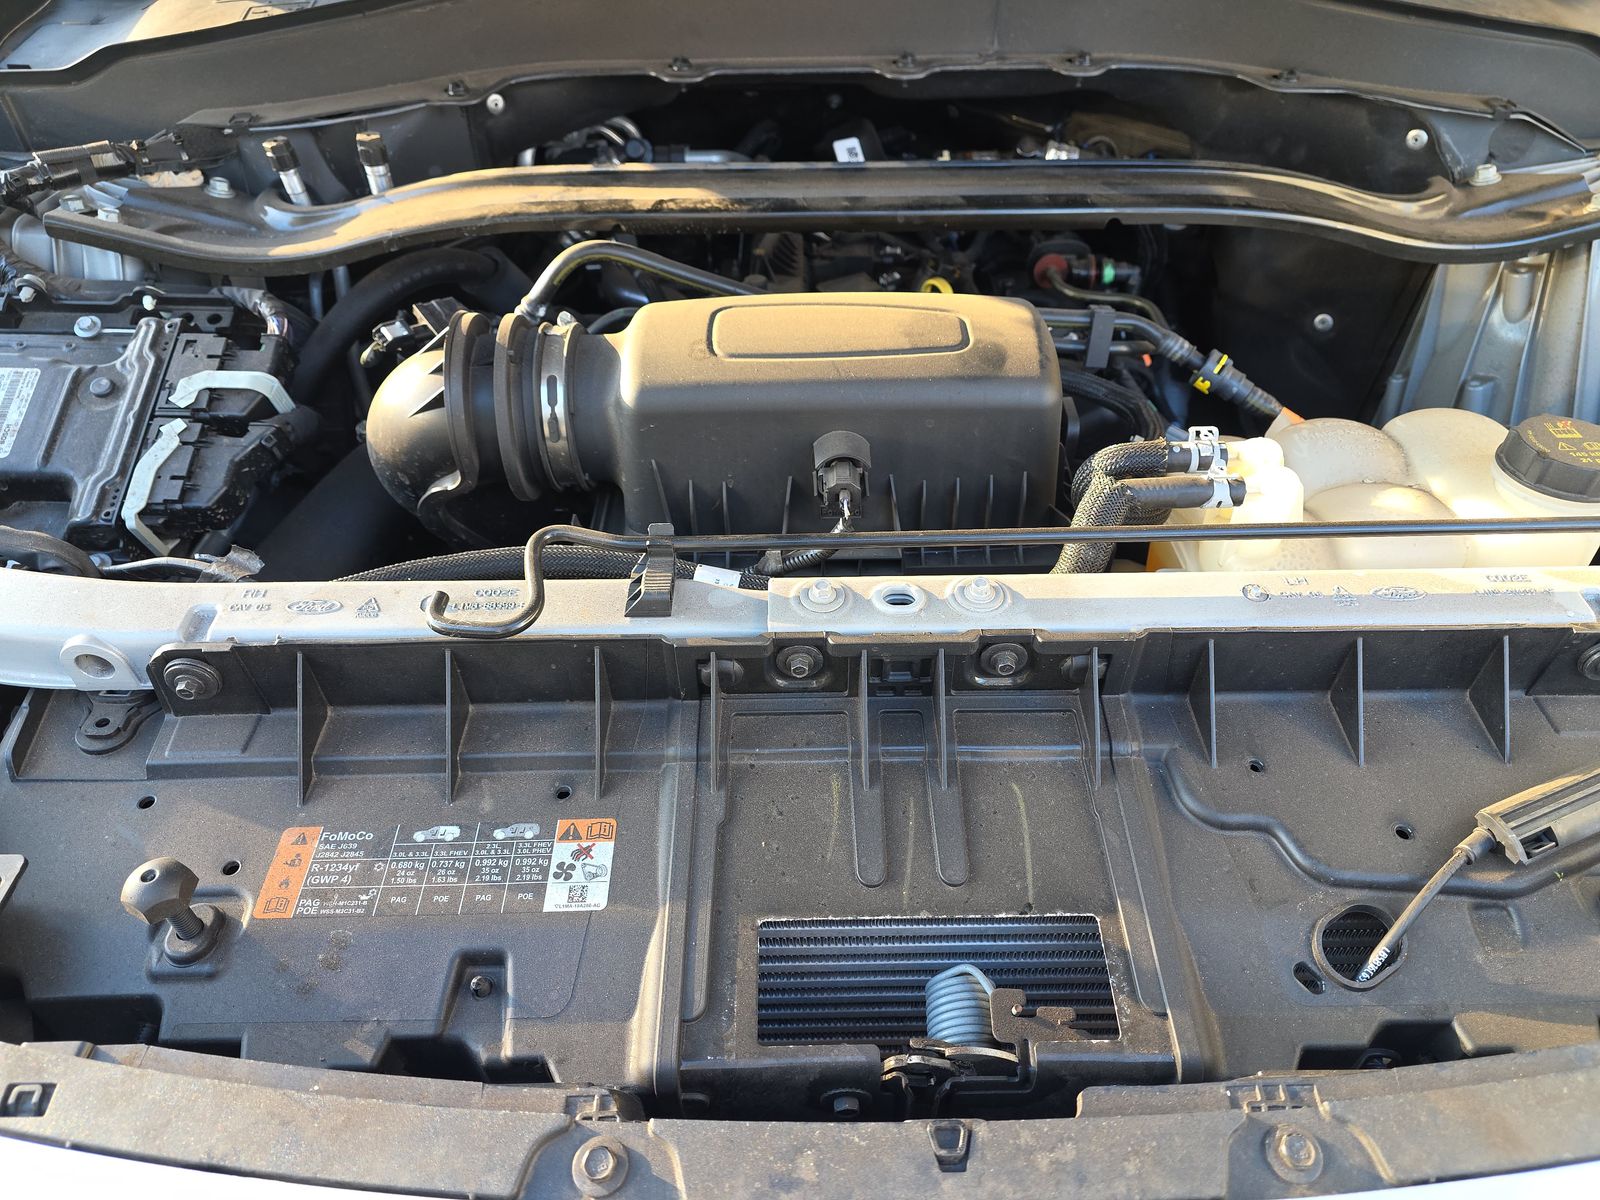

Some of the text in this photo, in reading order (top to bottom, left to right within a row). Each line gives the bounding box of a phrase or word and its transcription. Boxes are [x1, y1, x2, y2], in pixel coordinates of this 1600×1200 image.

[321, 831, 374, 841] FoMoCo
[338, 842, 358, 850] J639
[340, 850, 364, 858] J2845
[391, 860, 425, 870] 0.680 kg
[431, 860, 466, 869] 0.737 kg
[474, 858, 508, 867] 0.992 kg
[515, 858, 549, 866] 0.992 kg
[311, 862, 360, 873] R-1234yf
[306, 875, 352, 886] (GWP 4)
[299, 898, 320, 907] PAG
[296, 907, 319, 915] POE
